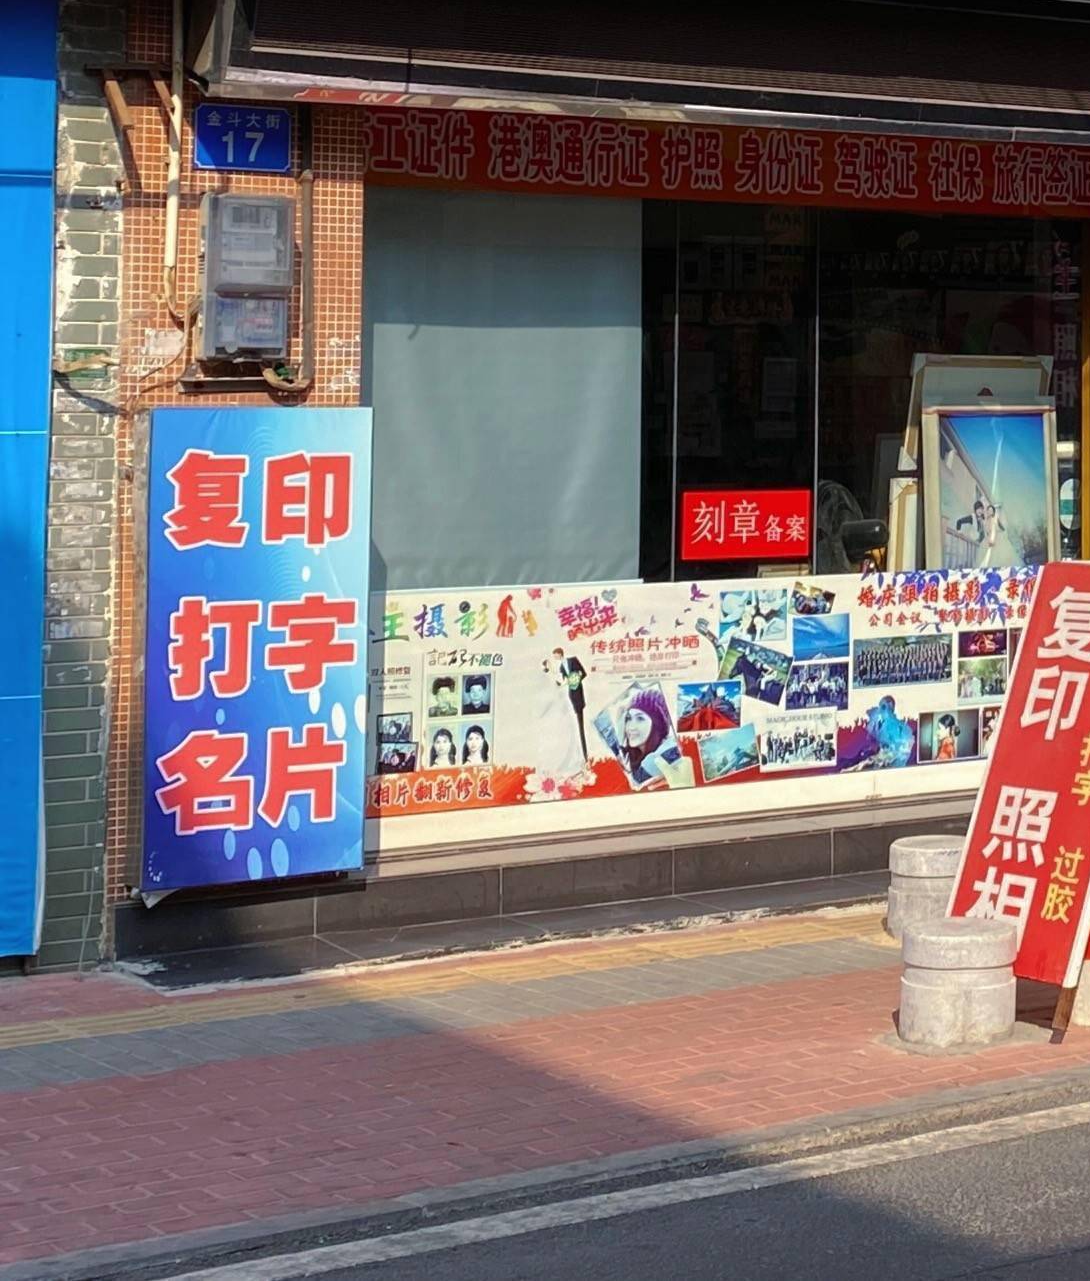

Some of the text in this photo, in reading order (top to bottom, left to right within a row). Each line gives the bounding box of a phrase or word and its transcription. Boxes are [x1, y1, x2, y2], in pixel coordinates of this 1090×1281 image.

[207, 111, 281, 129] 金斗大街
[222, 131, 264, 163] 17
[365, 111, 474, 180] 工证件
[488, 115, 648, 189] 港澳通行证
[661, 125, 722, 190] 护照
[735, 129, 823, 194] 身份证
[835, 135, 917, 198] 驾驶证
[929, 141, 984, 202] 社保
[164, 448, 352, 551] 复印
[690, 498, 807, 545] 刻章备案
[169, 593, 358, 701] 打字
[367, 600, 490, 644] 主摄影
[590, 634, 700, 655] 传统照片冲晒
[155, 722, 347, 837] 名片
[965, 784, 1058, 953] 照相
[1040, 845, 1086, 924] 过胶
